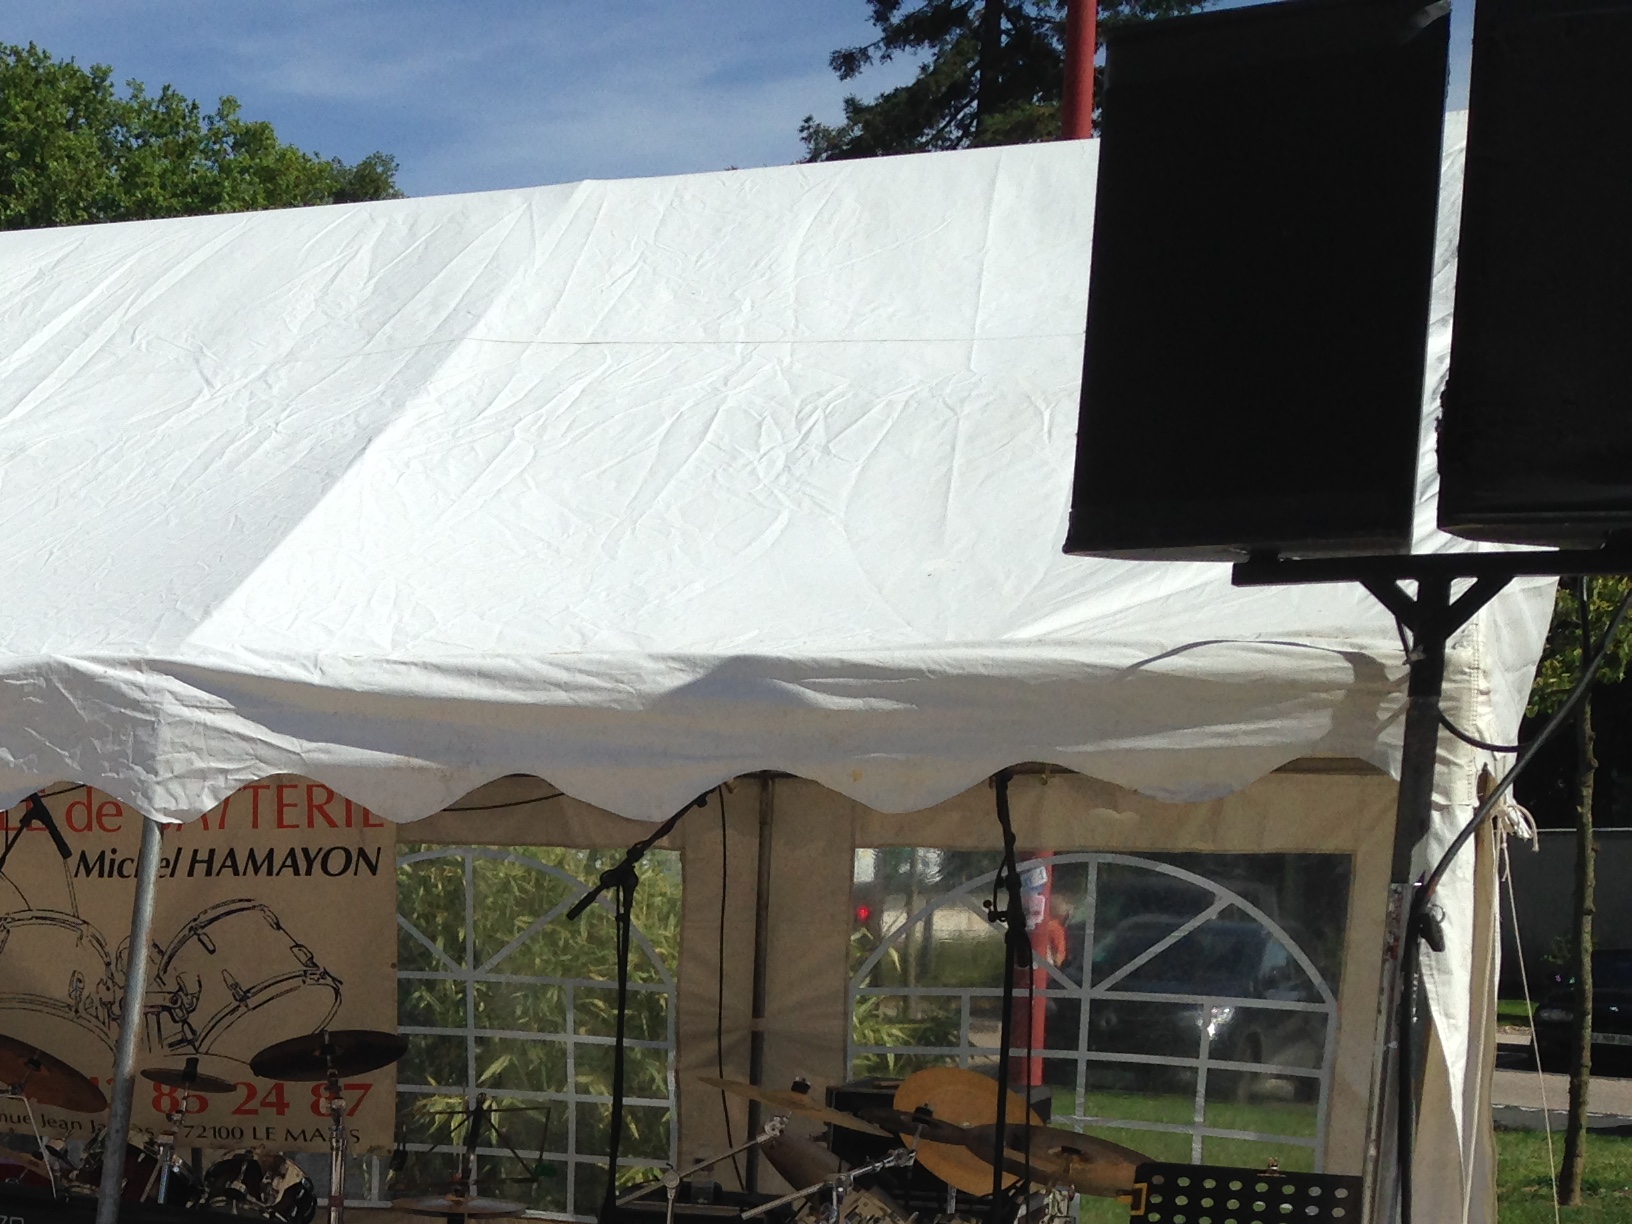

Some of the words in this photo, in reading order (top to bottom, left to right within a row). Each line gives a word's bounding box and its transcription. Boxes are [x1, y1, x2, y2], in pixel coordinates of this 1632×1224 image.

[66, 785, 123, 833] de
[74, 847, 182, 878] Micel
[187, 846, 381, 877] HAMAYON
[231, 1081, 290, 1117] 24
[311, 1081, 373, 1118] 87
[40, 1113, 83, 1132] Jean
[183, 1125, 244, 1141] 72100
[252, 1126, 277, 1142] LE
[284, 1127, 361, 1144] MAS
